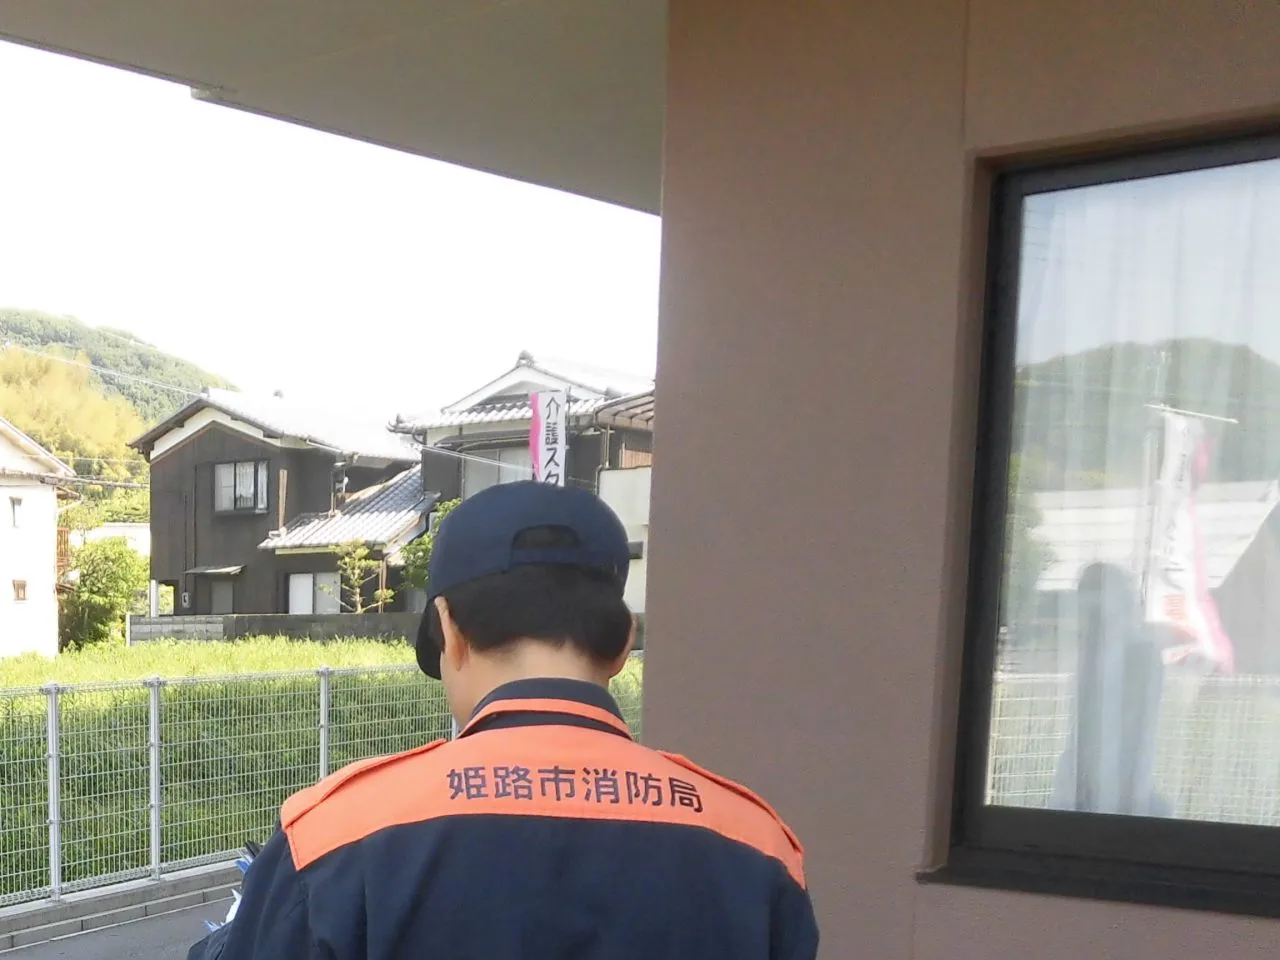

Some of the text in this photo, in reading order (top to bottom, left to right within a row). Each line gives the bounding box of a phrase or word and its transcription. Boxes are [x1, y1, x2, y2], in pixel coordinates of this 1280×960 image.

[446, 765, 704, 813] 姫路市消防局
